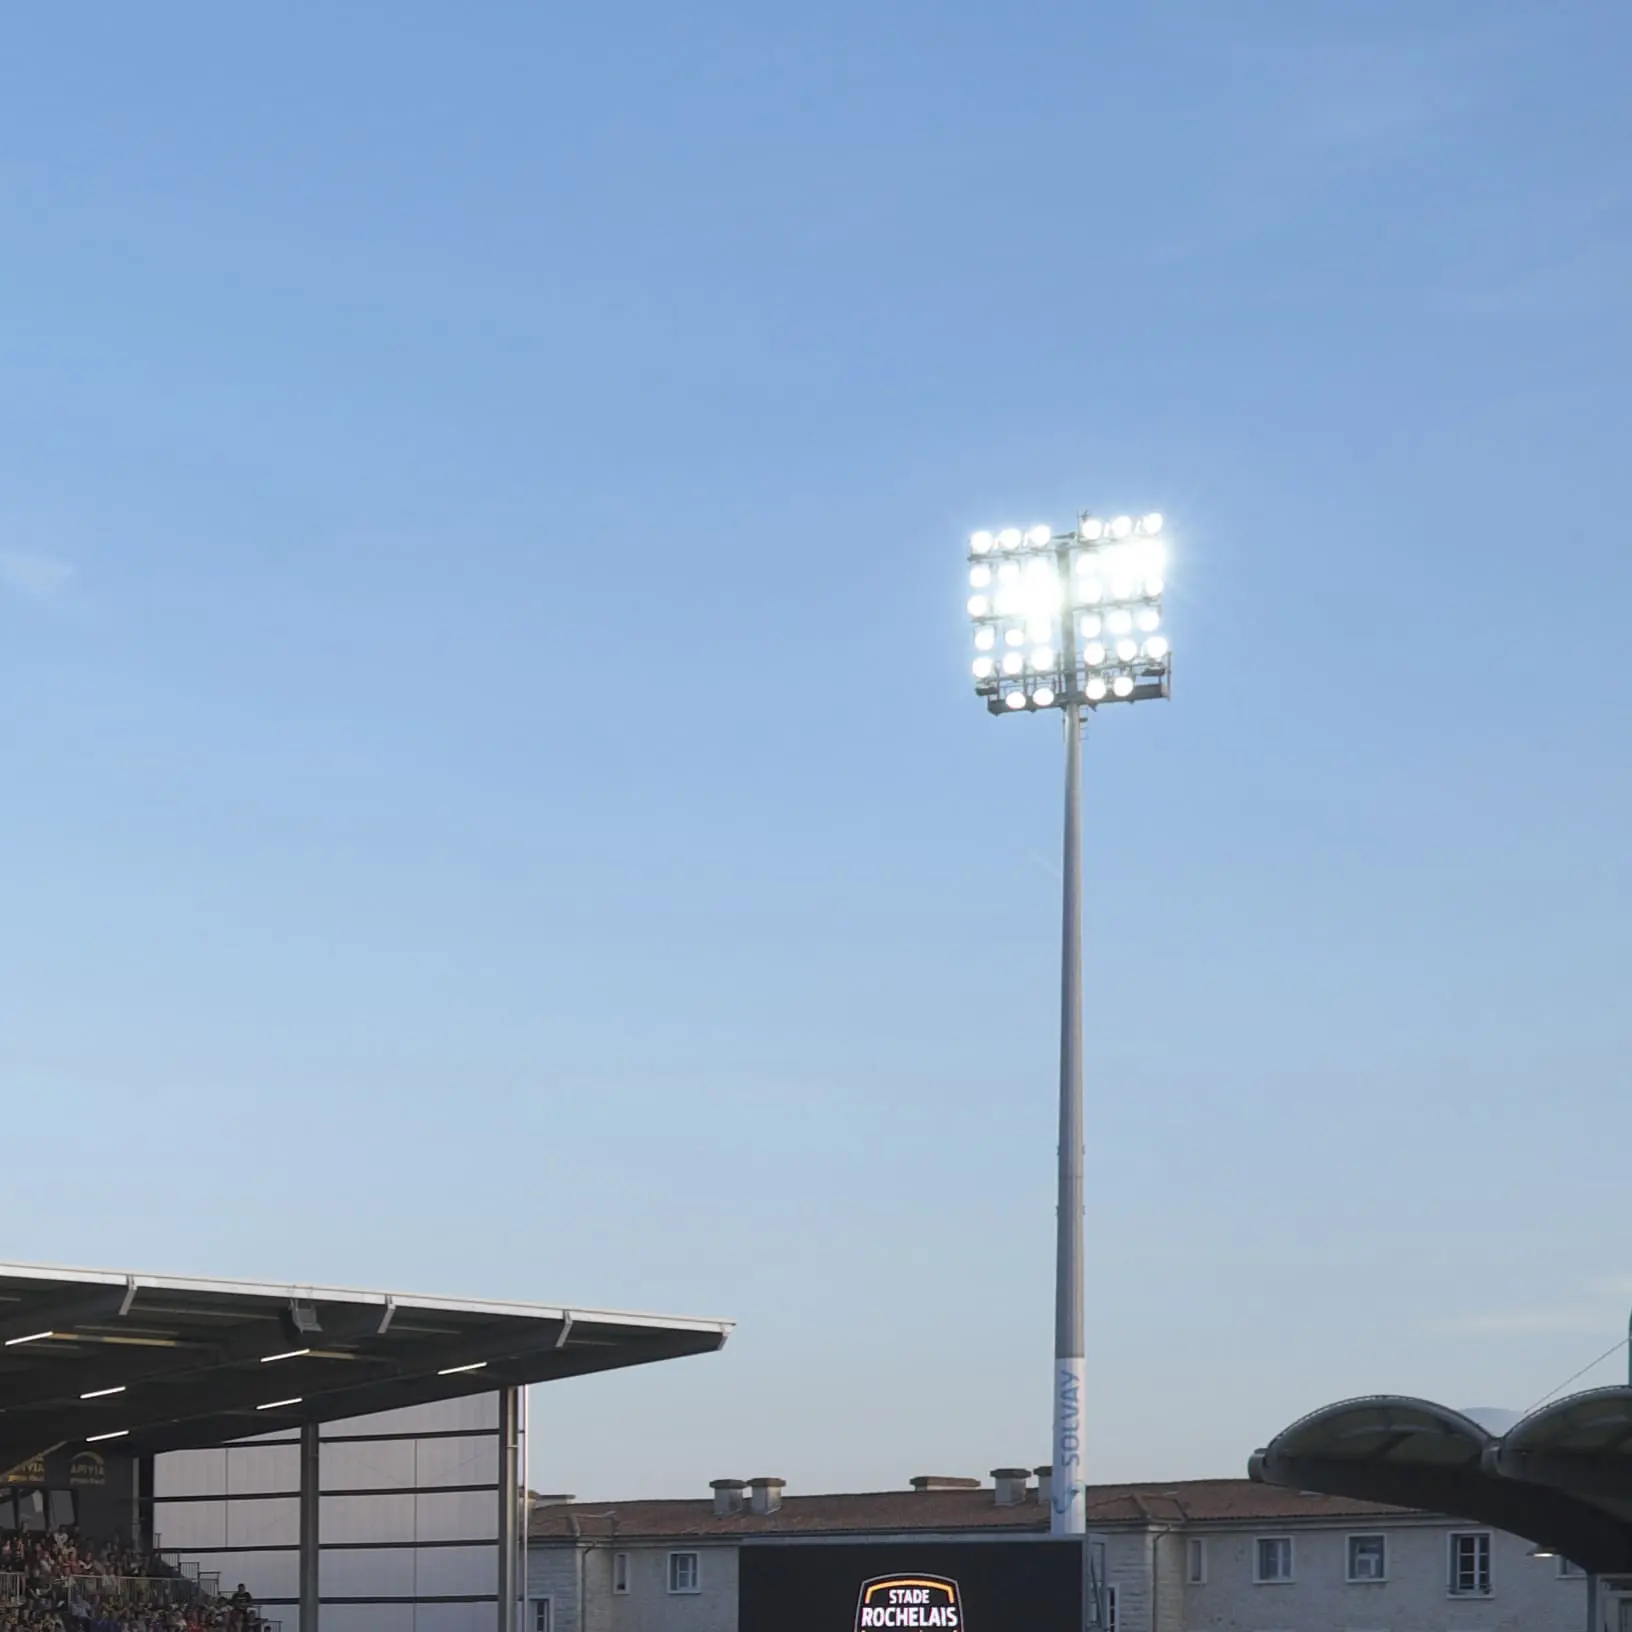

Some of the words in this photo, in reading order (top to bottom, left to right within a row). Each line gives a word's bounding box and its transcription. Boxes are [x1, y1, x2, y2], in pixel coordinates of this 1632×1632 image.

[1060, 1370, 1080, 1467] SOLVAY
[889, 1589, 930, 1604] STADE
[861, 1607, 958, 1627] ROCHELAIS
